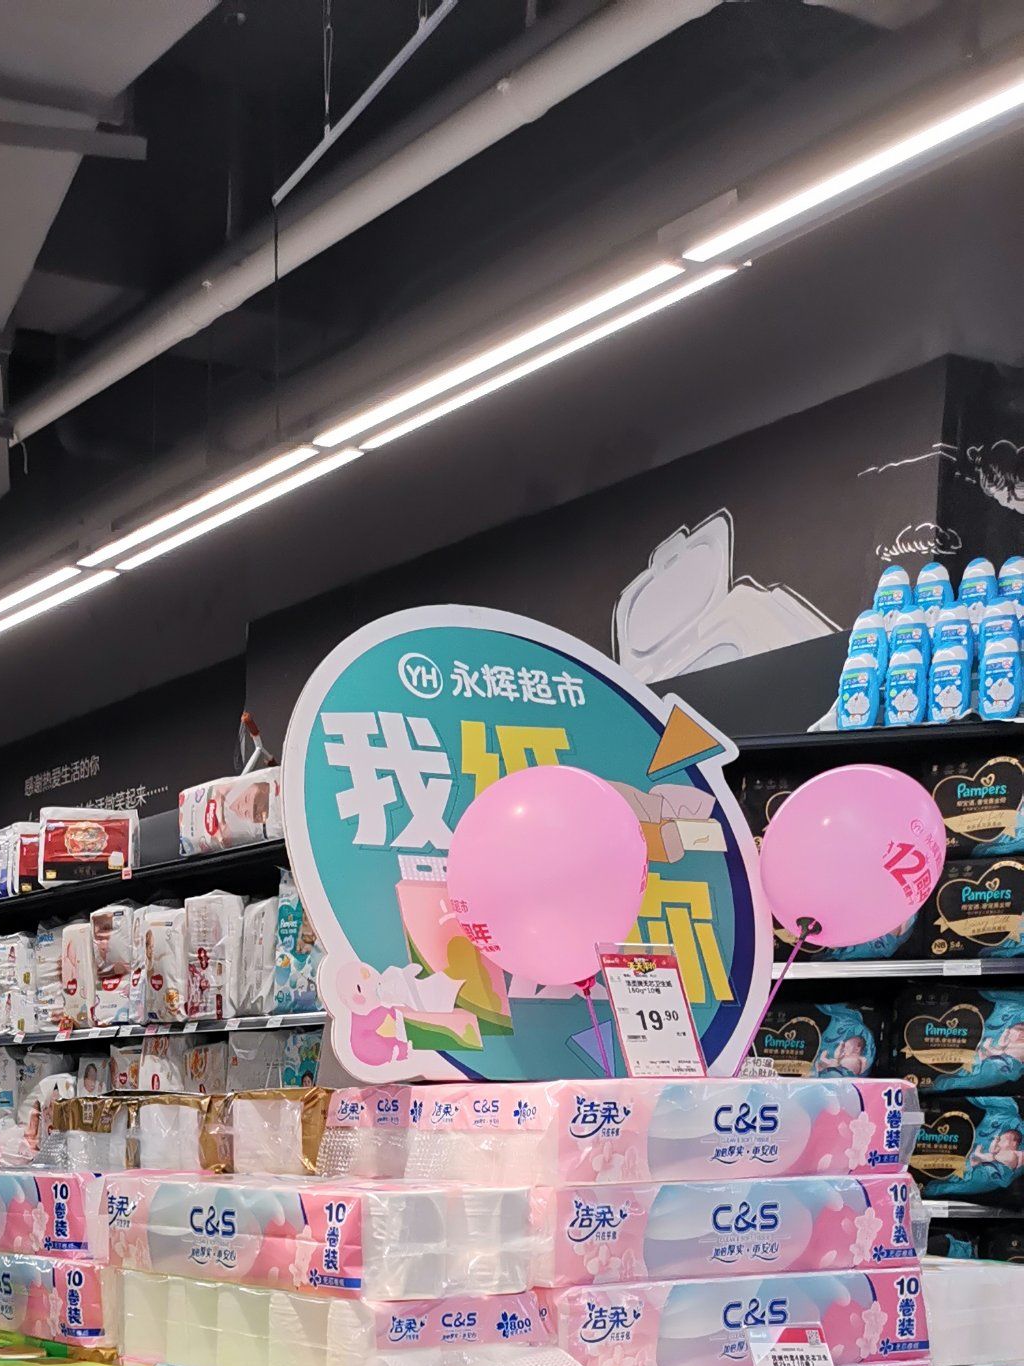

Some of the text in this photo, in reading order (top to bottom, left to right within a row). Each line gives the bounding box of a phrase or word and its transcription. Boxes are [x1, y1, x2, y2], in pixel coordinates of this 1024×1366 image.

[406, 664, 438, 689] YH
[450, 660, 586, 708] 永辉超市
[24, 755, 100, 797] 感谢热爱生活的你
[957, 782, 1007, 799] Pampers
[883, 843, 926, 887] 12
[961, 886, 1012, 903] Pampers
[636, 1009, 679, 1031] 19.90
[925, 1022, 968, 1038] Pampers
[765, 1034, 806, 1049] Pampers
[377, 1099, 399, 1112] C&S
[473, 1099, 499, 1114] C&S
[883, 1088, 904, 1107] 10
[573, 1098, 624, 1128] 洁柔
[714, 1103, 779, 1135] C&S
[52, 1184, 69, 1200] 10
[889, 1184, 908, 1202] 10
[189, 1206, 236, 1237] C&S
[325, 1202, 346, 1224] 10
[570, 1203, 622, 1233] 洁柔
[712, 1201, 779, 1233] C&S
[67, 1271, 83, 1287] 10
[895, 1277, 920, 1296] 10
[441, 1312, 477, 1328] C&S
[585, 1303, 633, 1333] 洁柔
[722, 1298, 788, 1329] C&S
[504, 1317, 532, 1331] 1800
